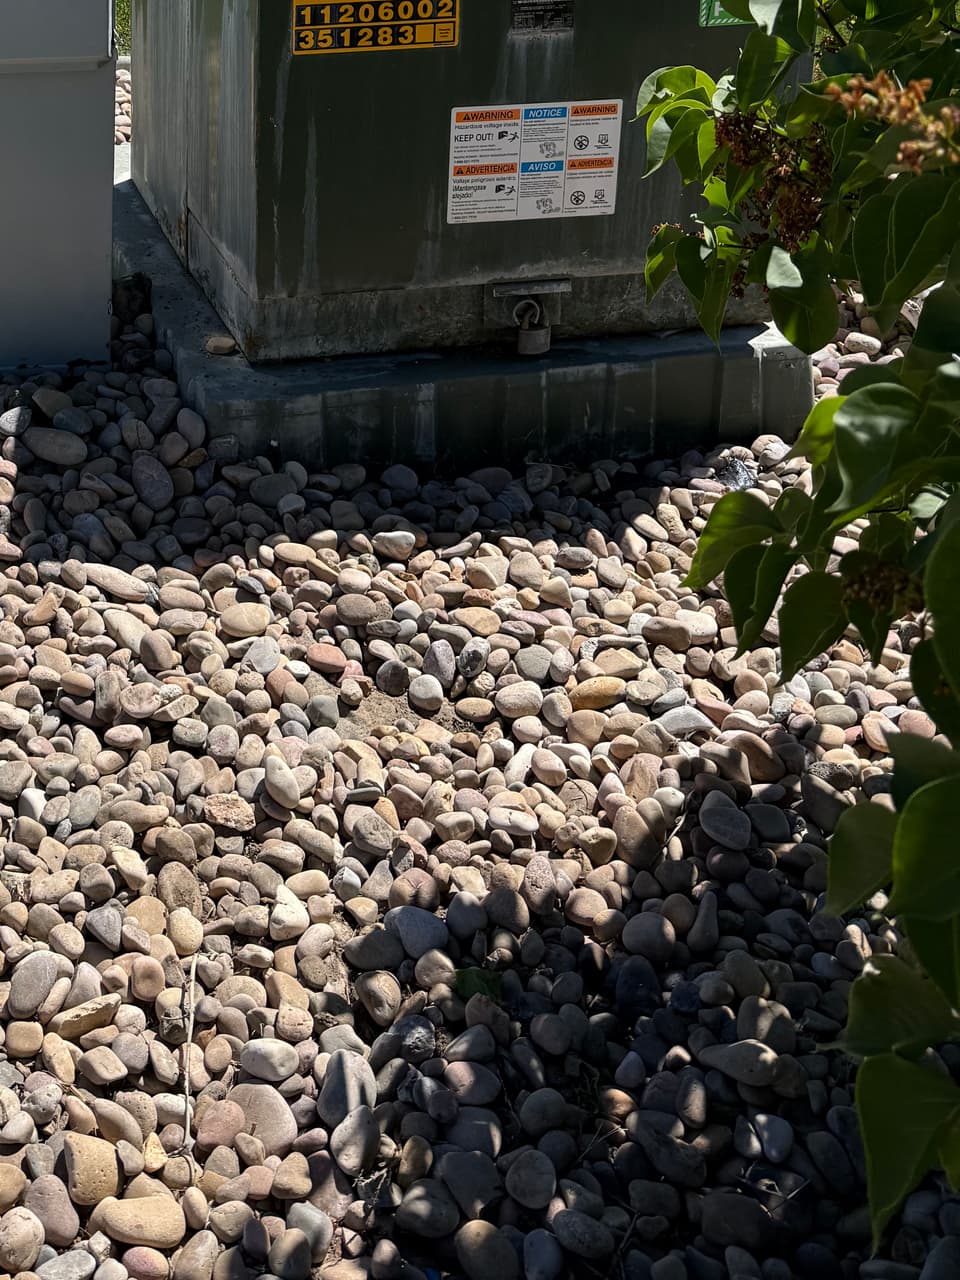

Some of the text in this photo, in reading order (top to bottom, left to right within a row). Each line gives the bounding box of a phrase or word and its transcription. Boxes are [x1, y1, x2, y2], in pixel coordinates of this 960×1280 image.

[298, 25, 414, 49] 351283
[528, 108, 562, 118] NOTICE
[579, 105, 616, 114] WARNING
[470, 110, 514, 120] WARNING
[454, 133, 494, 142] KEEP OUT!
[465, 163, 515, 174] ADVERTENCIA
[527, 162, 556, 171] AVISO
